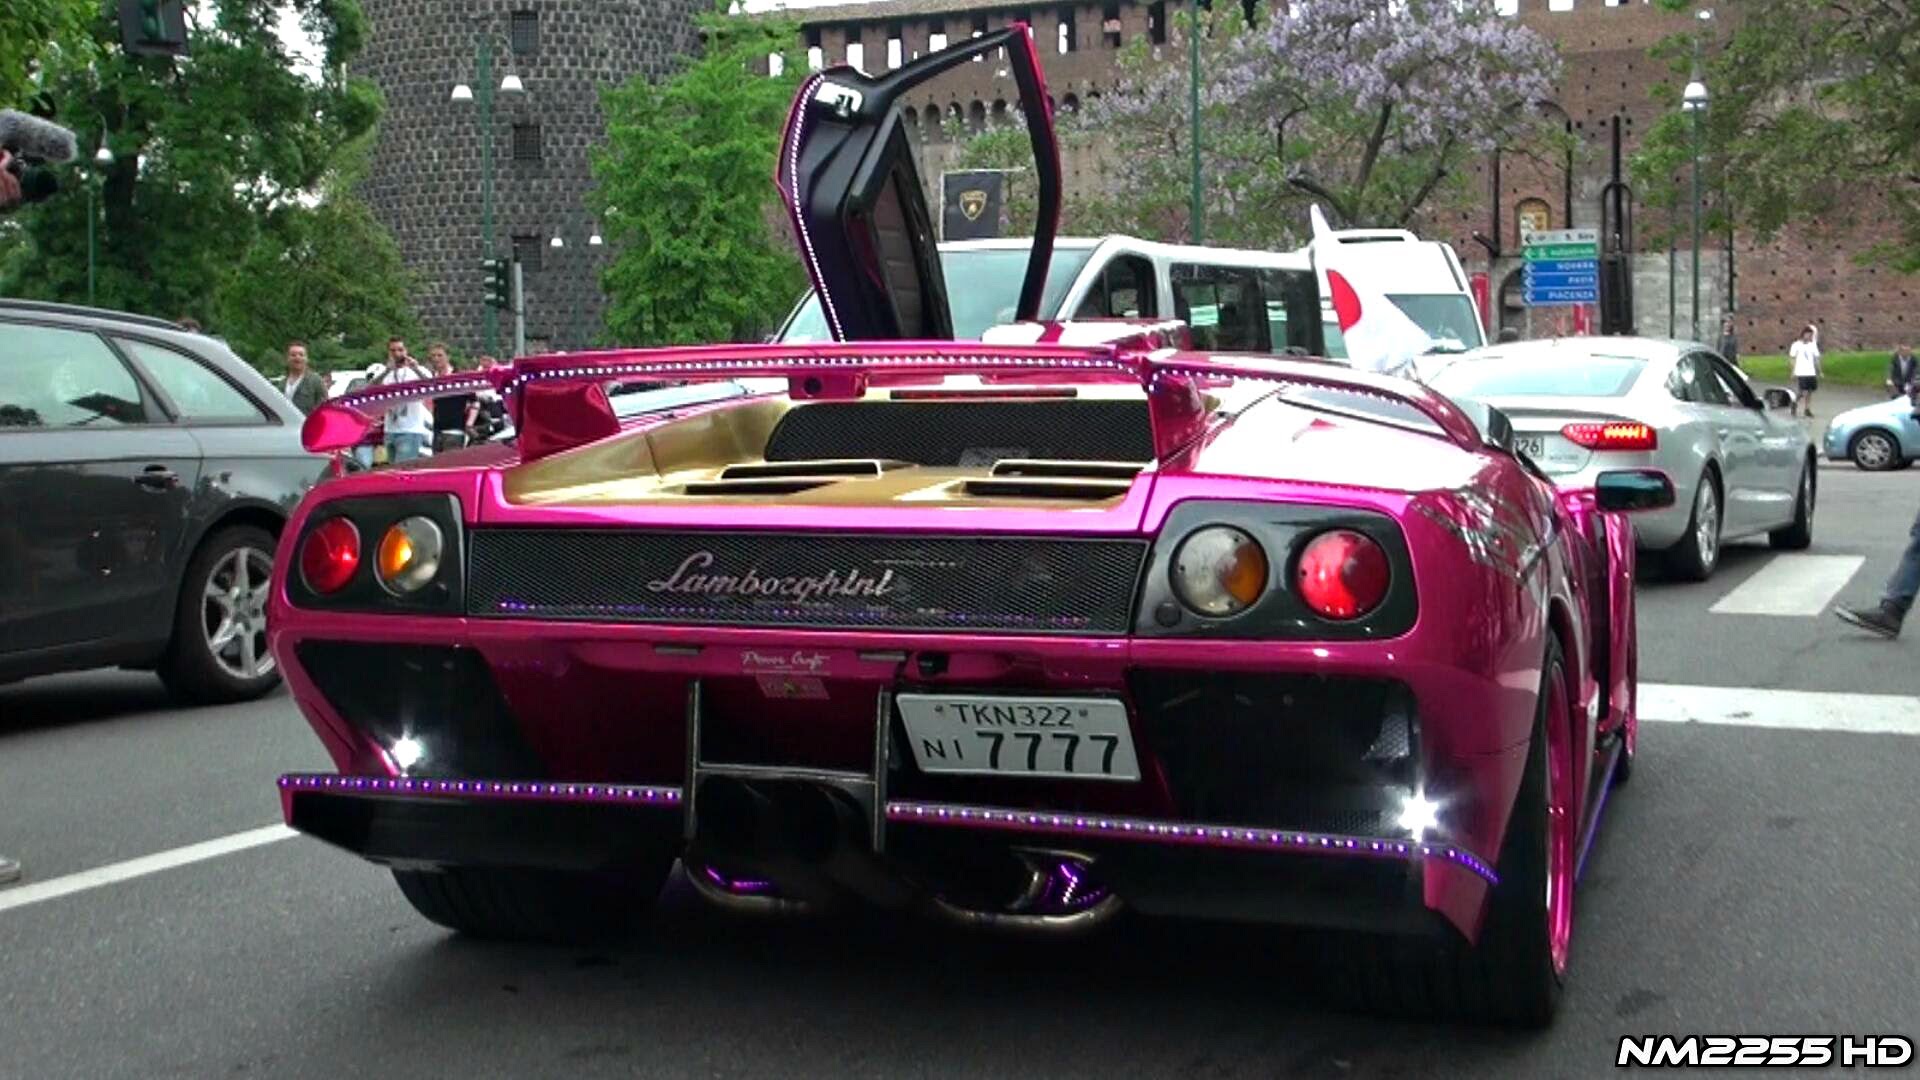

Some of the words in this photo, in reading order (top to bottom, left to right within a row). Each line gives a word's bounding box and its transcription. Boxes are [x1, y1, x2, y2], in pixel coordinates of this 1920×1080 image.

[1548, 291, 1594, 300] PIACENZA
[648, 551, 894, 606] Lamborghini
[950, 703, 1074, 727] TKN322
[976, 731, 1120, 774] 7777
